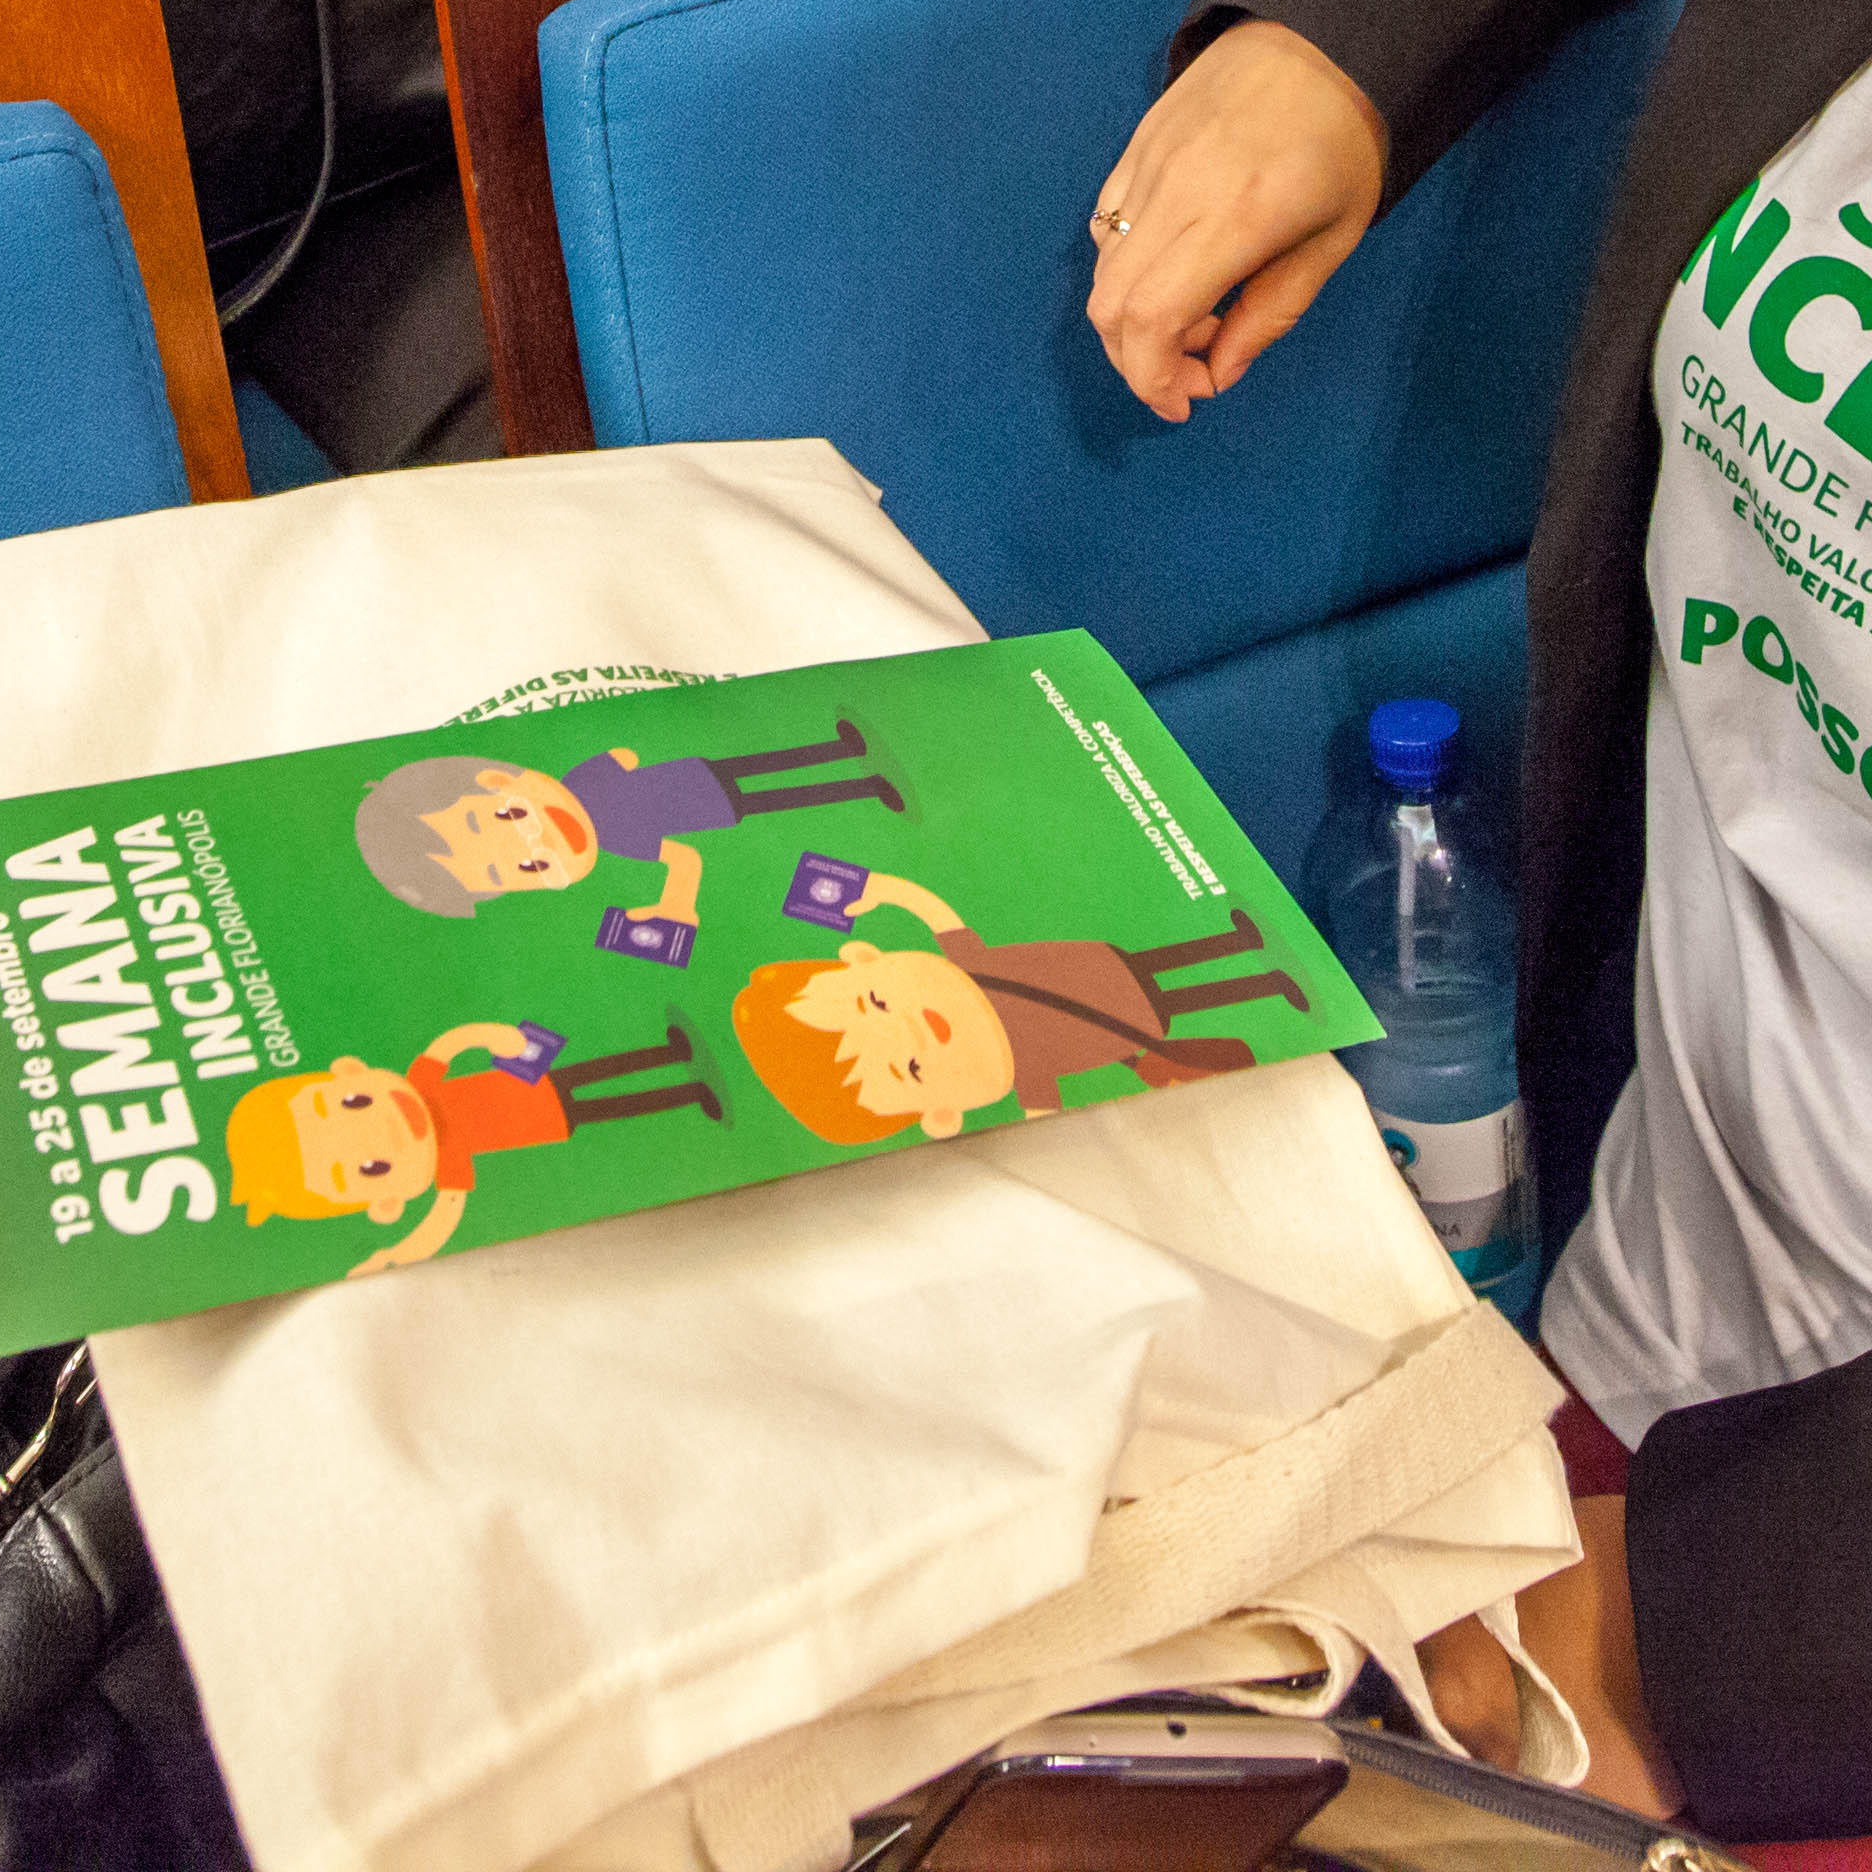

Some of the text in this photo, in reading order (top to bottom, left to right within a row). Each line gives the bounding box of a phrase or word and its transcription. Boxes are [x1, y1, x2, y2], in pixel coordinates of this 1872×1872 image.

[1680, 421, 1801, 544] TRABALHO
[1681, 354, 1851, 518] GRANDE
[1732, 495, 1748, 521] E
[550, 668, 589, 686] AS
[1029, 668, 1204, 901] TRABALHO VALORIZA A COMPETÊNCIA
[1091, 720, 1227, 897] E RESPEITA AS DIFERENÇAS
[113, 813, 259, 1080] INCLUSIVA
[177, 808, 301, 1068] GRANDE FLORIANÓPOLIS
[4, 825, 218, 1235] SEMANA
[19, 1055, 60, 1101] de
[29, 1104, 75, 1154] 25
[50, 1158, 83, 1186] a
[50, 1194, 95, 1245] 19
